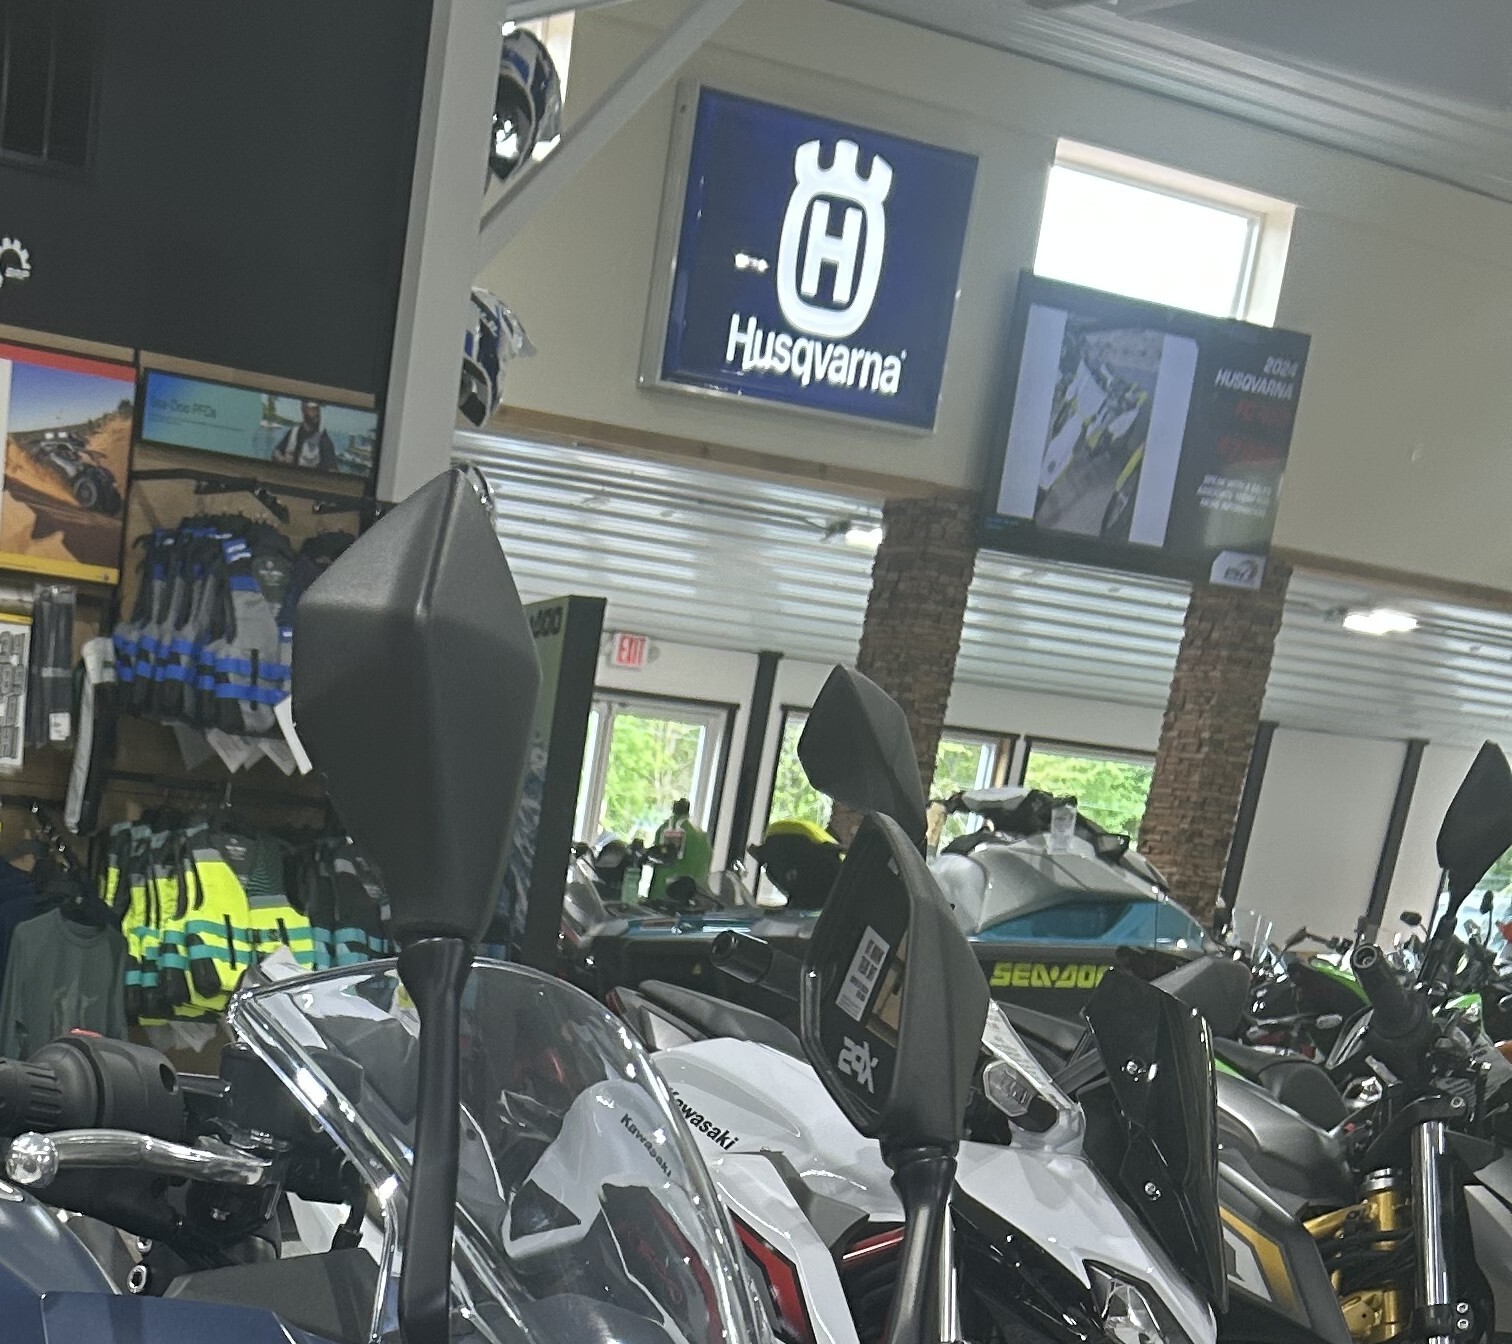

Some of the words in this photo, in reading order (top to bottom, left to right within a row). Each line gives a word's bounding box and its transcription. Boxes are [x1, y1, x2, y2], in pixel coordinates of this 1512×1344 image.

[725, 313, 904, 395] Husqvarna
[1263, 356, 1299, 378] 2024
[1214, 368, 1294, 400] HUSQVARNA
[617, 633, 648, 667] EXIT
